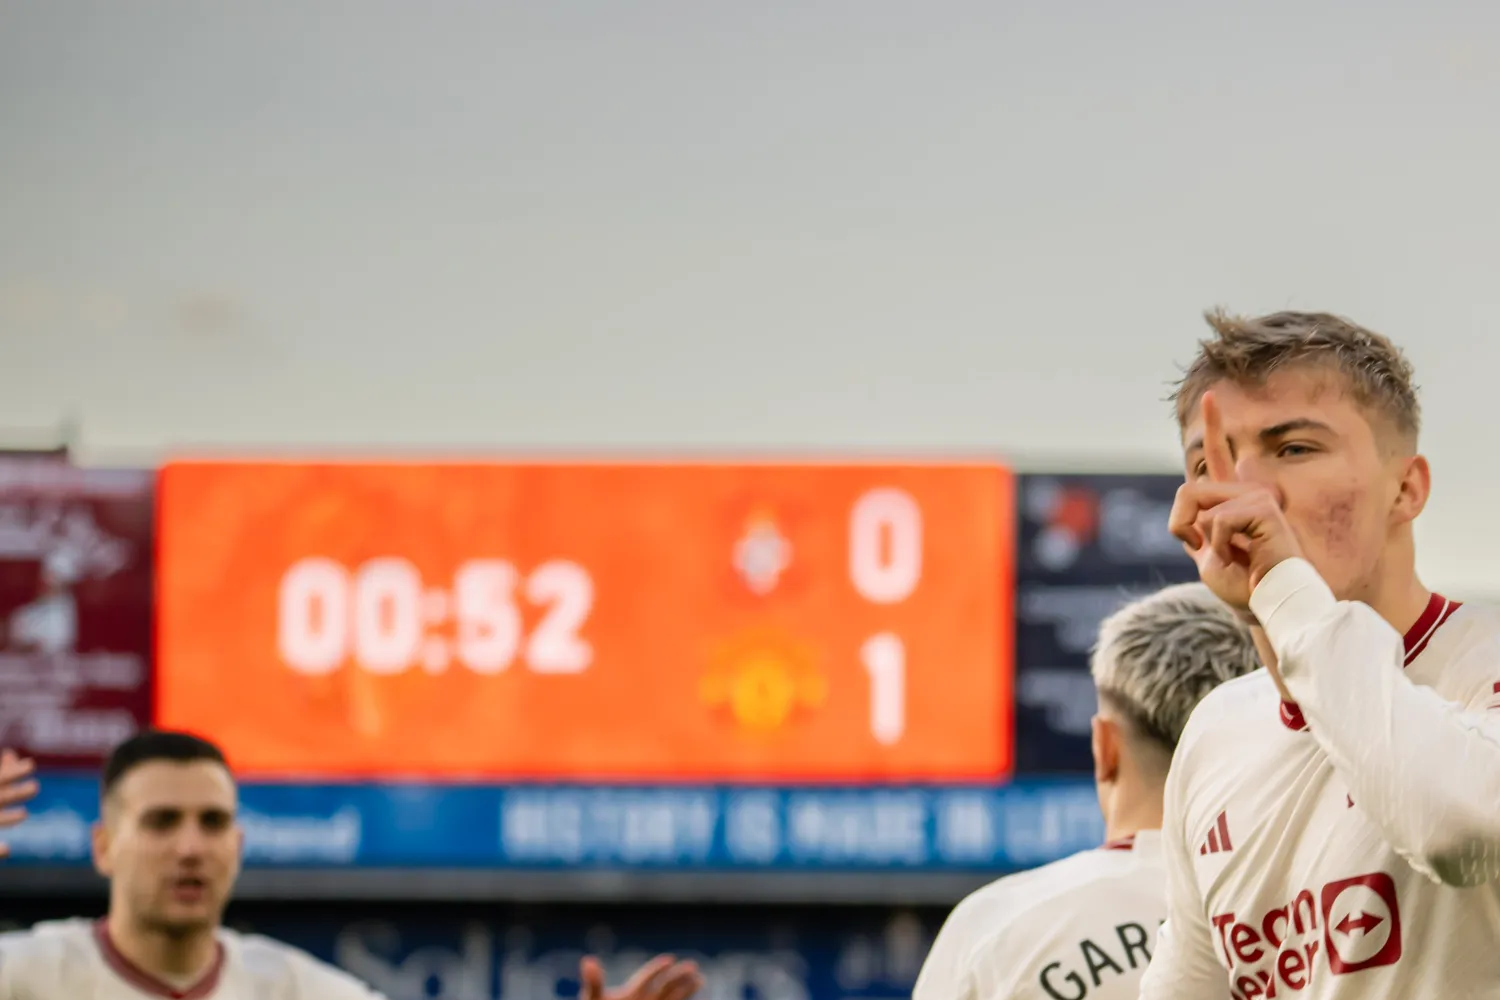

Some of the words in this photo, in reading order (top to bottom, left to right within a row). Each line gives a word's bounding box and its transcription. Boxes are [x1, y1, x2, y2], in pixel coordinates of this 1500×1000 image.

[847, 487, 922, 603] 0
[279, 556, 594, 676] 00:52
[860, 632, 905, 745] 1
